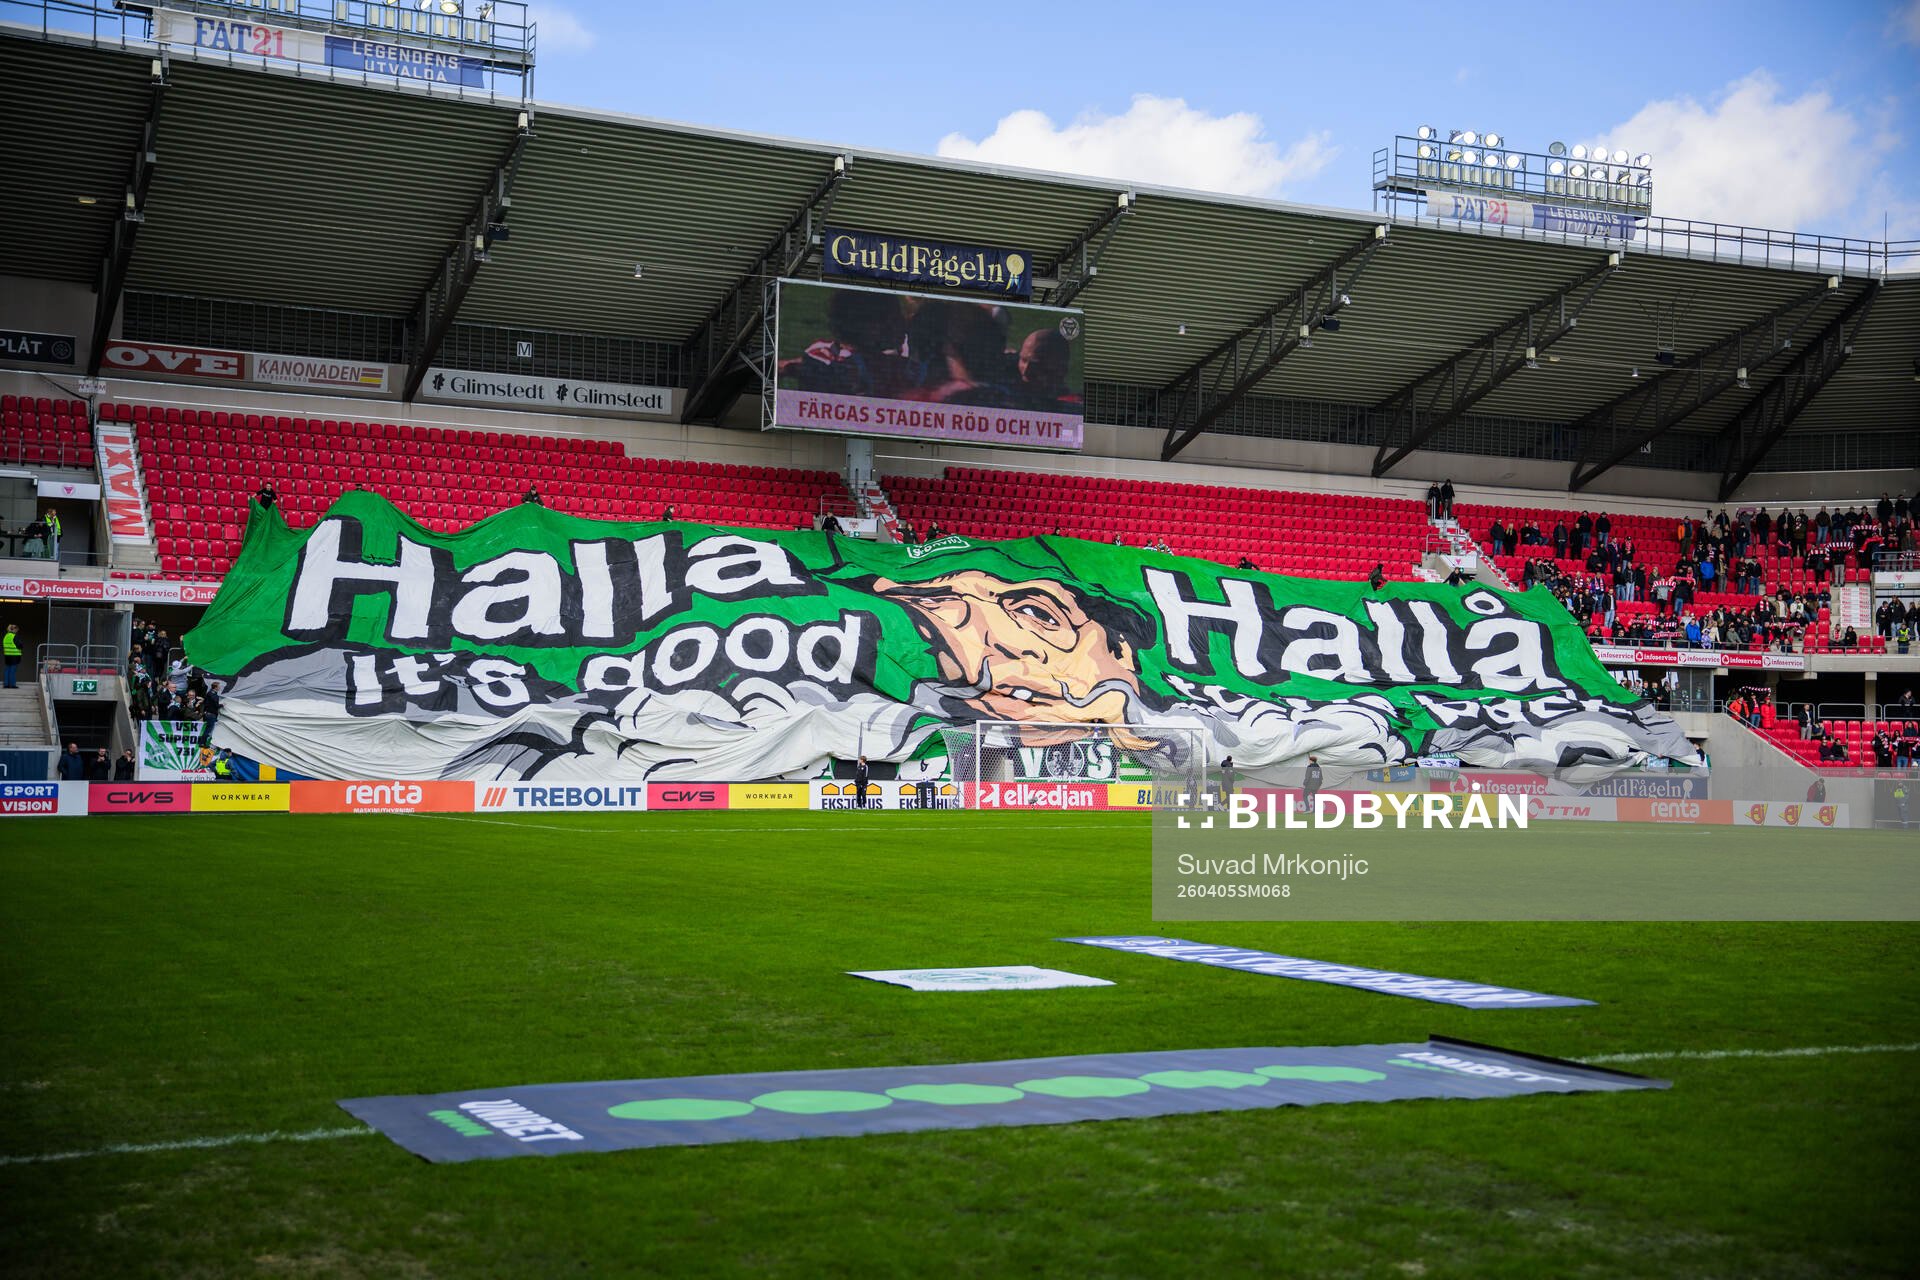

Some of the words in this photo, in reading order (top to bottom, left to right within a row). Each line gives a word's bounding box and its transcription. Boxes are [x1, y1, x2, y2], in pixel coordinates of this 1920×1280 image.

[194, 17, 285, 59] FAT21
[352, 42, 460, 70] LEGENDENS
[365, 59, 447, 82] UTVALDA
[1452, 195, 1508, 224] FAT21
[1550, 207, 1619, 224] LEGENDENS
[831, 235, 1005, 287] GuldFågeln
[106, 346, 238, 376] OVE
[518, 344, 531, 356] M
[258, 359, 361, 381] KANONADEN
[450, 376, 545, 400] Glimstedt
[573, 387, 663, 409] Glimstedt
[799, 400, 869, 423] FÄRGAS
[876, 407, 945, 429] STADEN
[951, 411, 990, 433] RÖD
[996, 418, 1031, 437] OCH
[1035, 421, 1064, 439] VIT
[102, 435, 145, 536] MAXI
[41, 585, 101, 595] infoservice
[121, 588, 179, 598] infoservice
[1142, 566, 1568, 692] Hallå
[1600, 652, 1635, 661] infoservice
[1643, 653, 1678, 662] infoservice
[1686, 654, 1721, 664] infoservice
[1729, 656, 1762, 666] infoservice
[1771, 658, 1803, 667] infoservice
[350, 651, 533, 707] It's
[4, 786, 54, 796] SPORT
[107, 792, 174, 804] CWS
[345, 781, 423, 805] renta
[513, 787, 642, 808] TREBOLIT
[662, 791, 716, 802] CWS
[2, 801, 52, 811] VISION
[1546, 804, 1591, 817] TTM
[1650, 800, 1700, 818] renta
[458, 1098, 585, 1142] UNIBET
